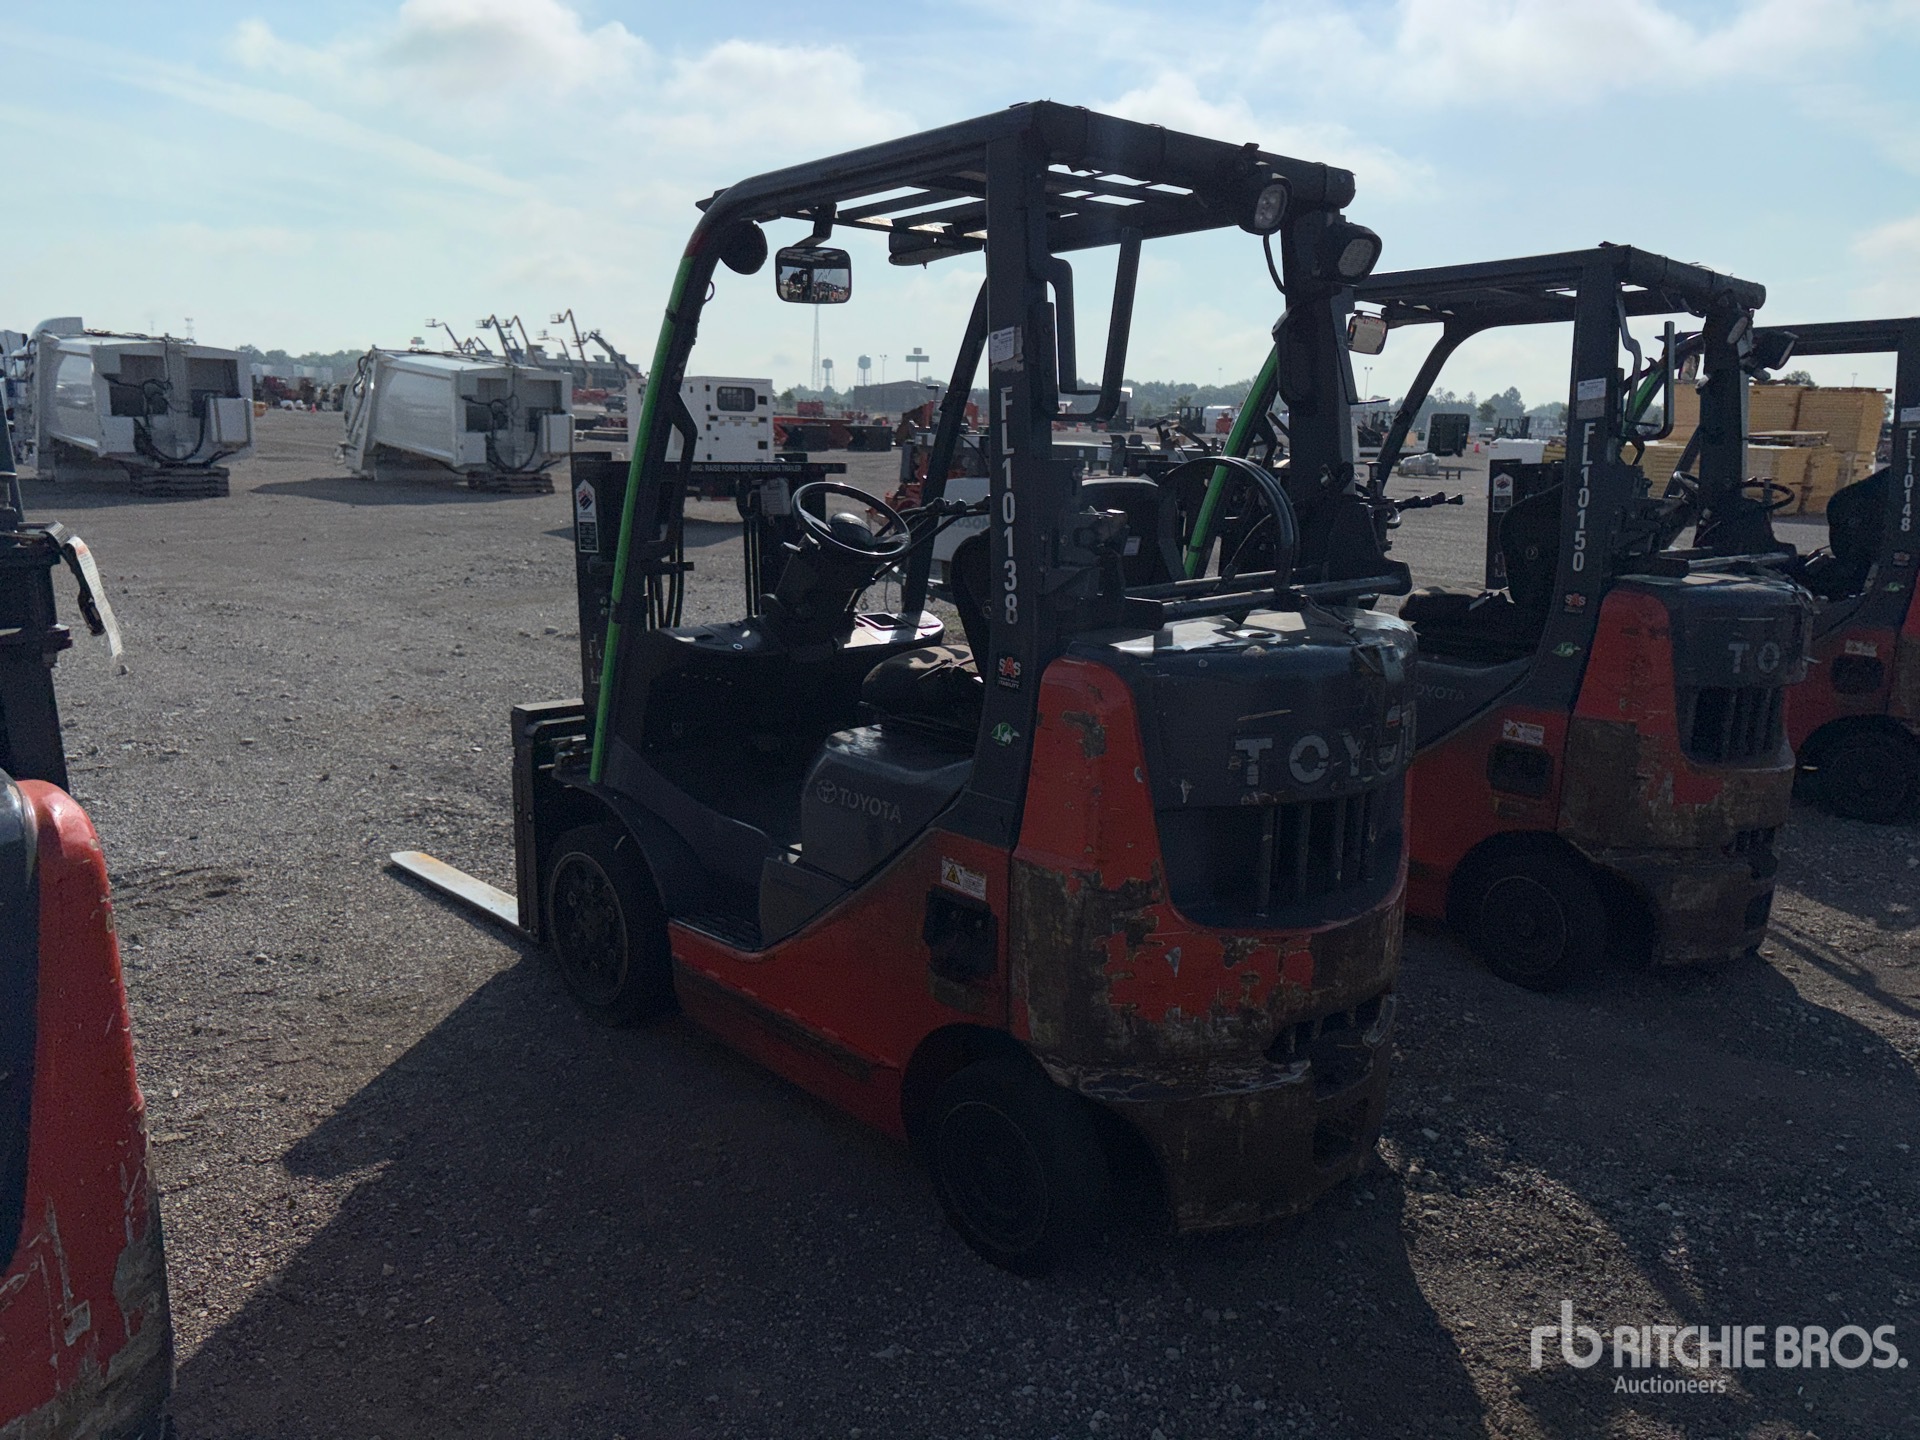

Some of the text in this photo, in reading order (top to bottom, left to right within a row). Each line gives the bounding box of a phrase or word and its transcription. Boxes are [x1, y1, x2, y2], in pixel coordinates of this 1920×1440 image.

[1000, 386, 1018, 624] FL10138
[1572, 422, 1596, 572] FL10150
[839, 787, 901, 824] TOYOTA
